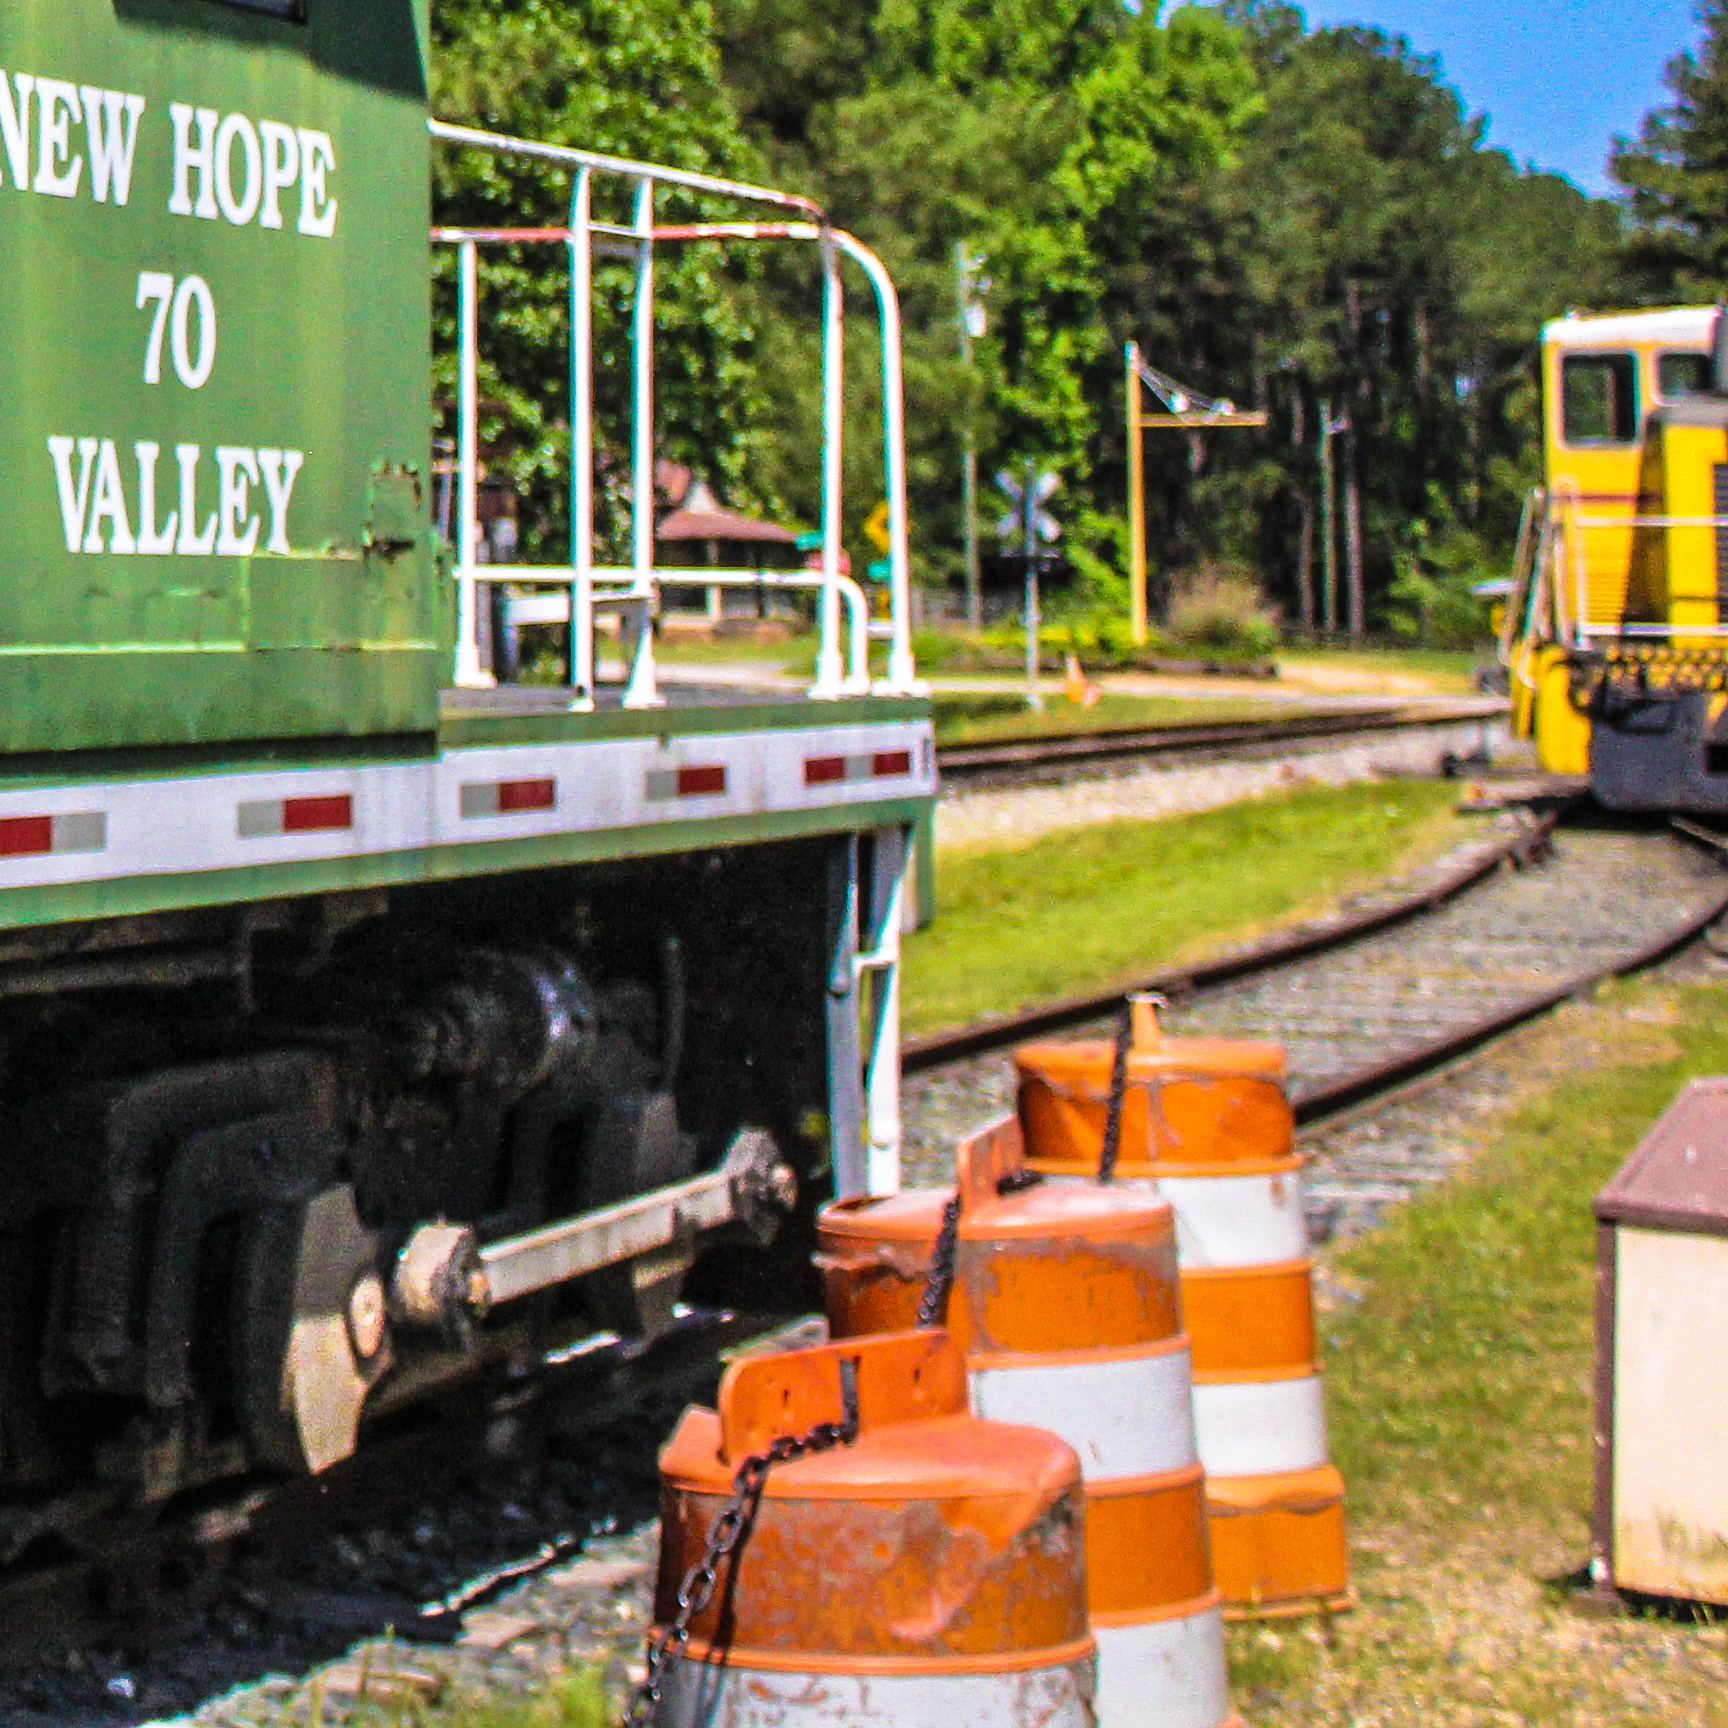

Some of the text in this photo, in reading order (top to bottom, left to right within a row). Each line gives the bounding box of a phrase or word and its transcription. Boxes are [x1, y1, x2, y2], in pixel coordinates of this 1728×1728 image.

[168, 102, 339, 239] HOPE
[135, 272, 217, 389] 70
[47, 435, 305, 556] VALLEY
